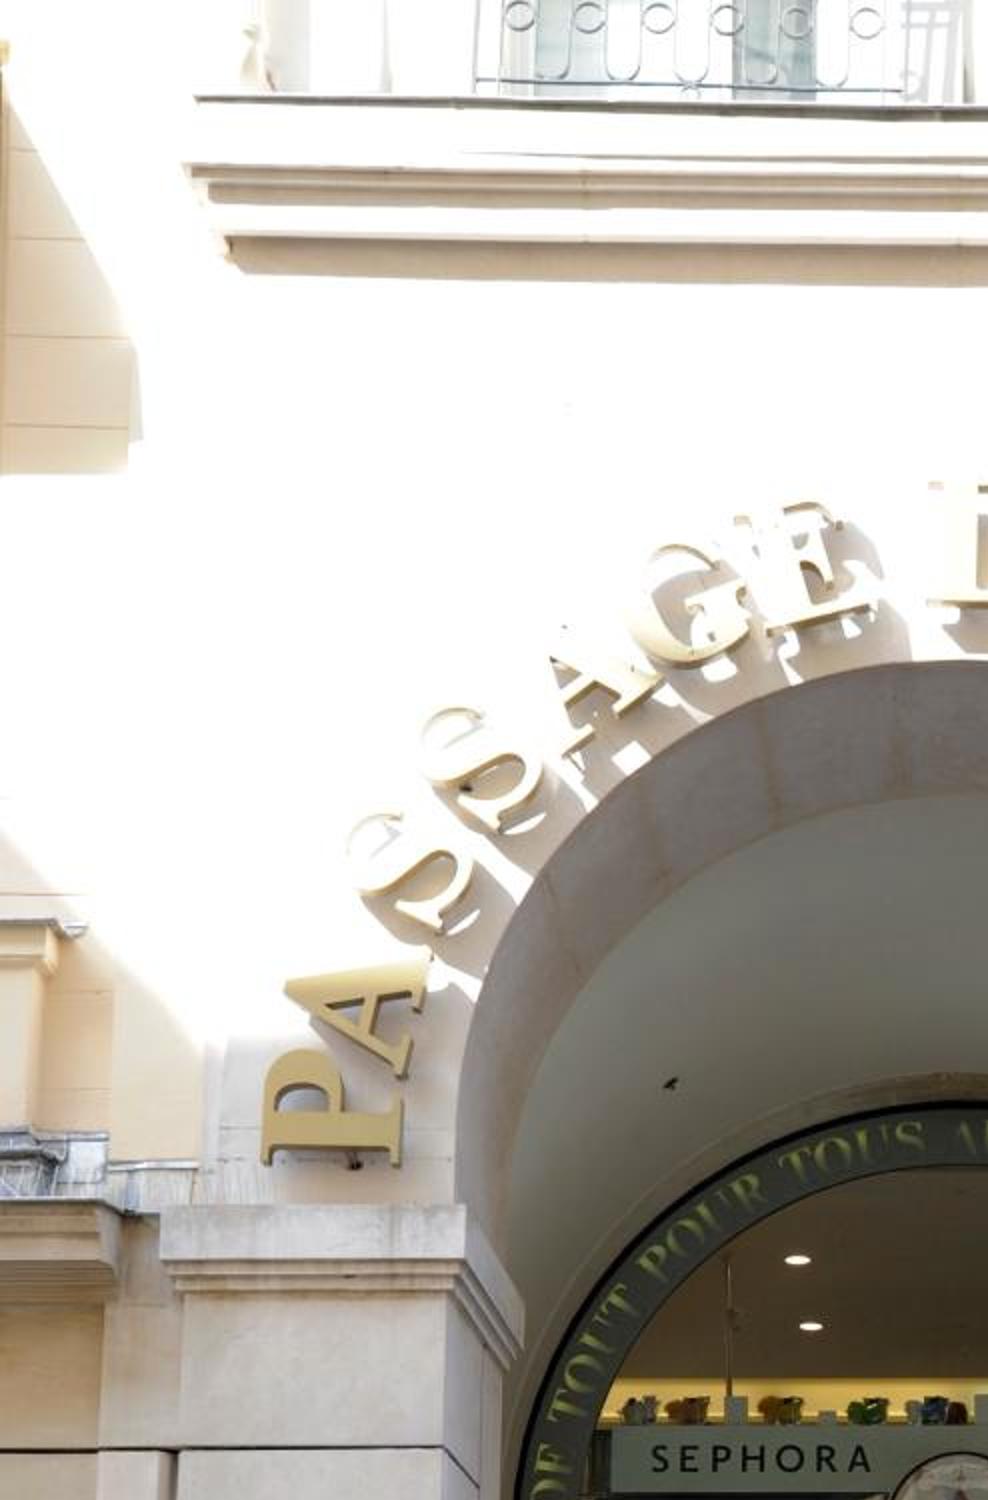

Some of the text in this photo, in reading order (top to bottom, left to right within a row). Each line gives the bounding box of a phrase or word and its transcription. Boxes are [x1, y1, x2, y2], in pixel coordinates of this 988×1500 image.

[260, 500, 880, 1169] PASSAGE
[547, 1282, 640, 1424] TOUT
[634, 1173, 767, 1281] POUR
[777, 1120, 927, 1186] TOUS
[651, 1444, 872, 1474] SEPHORA
